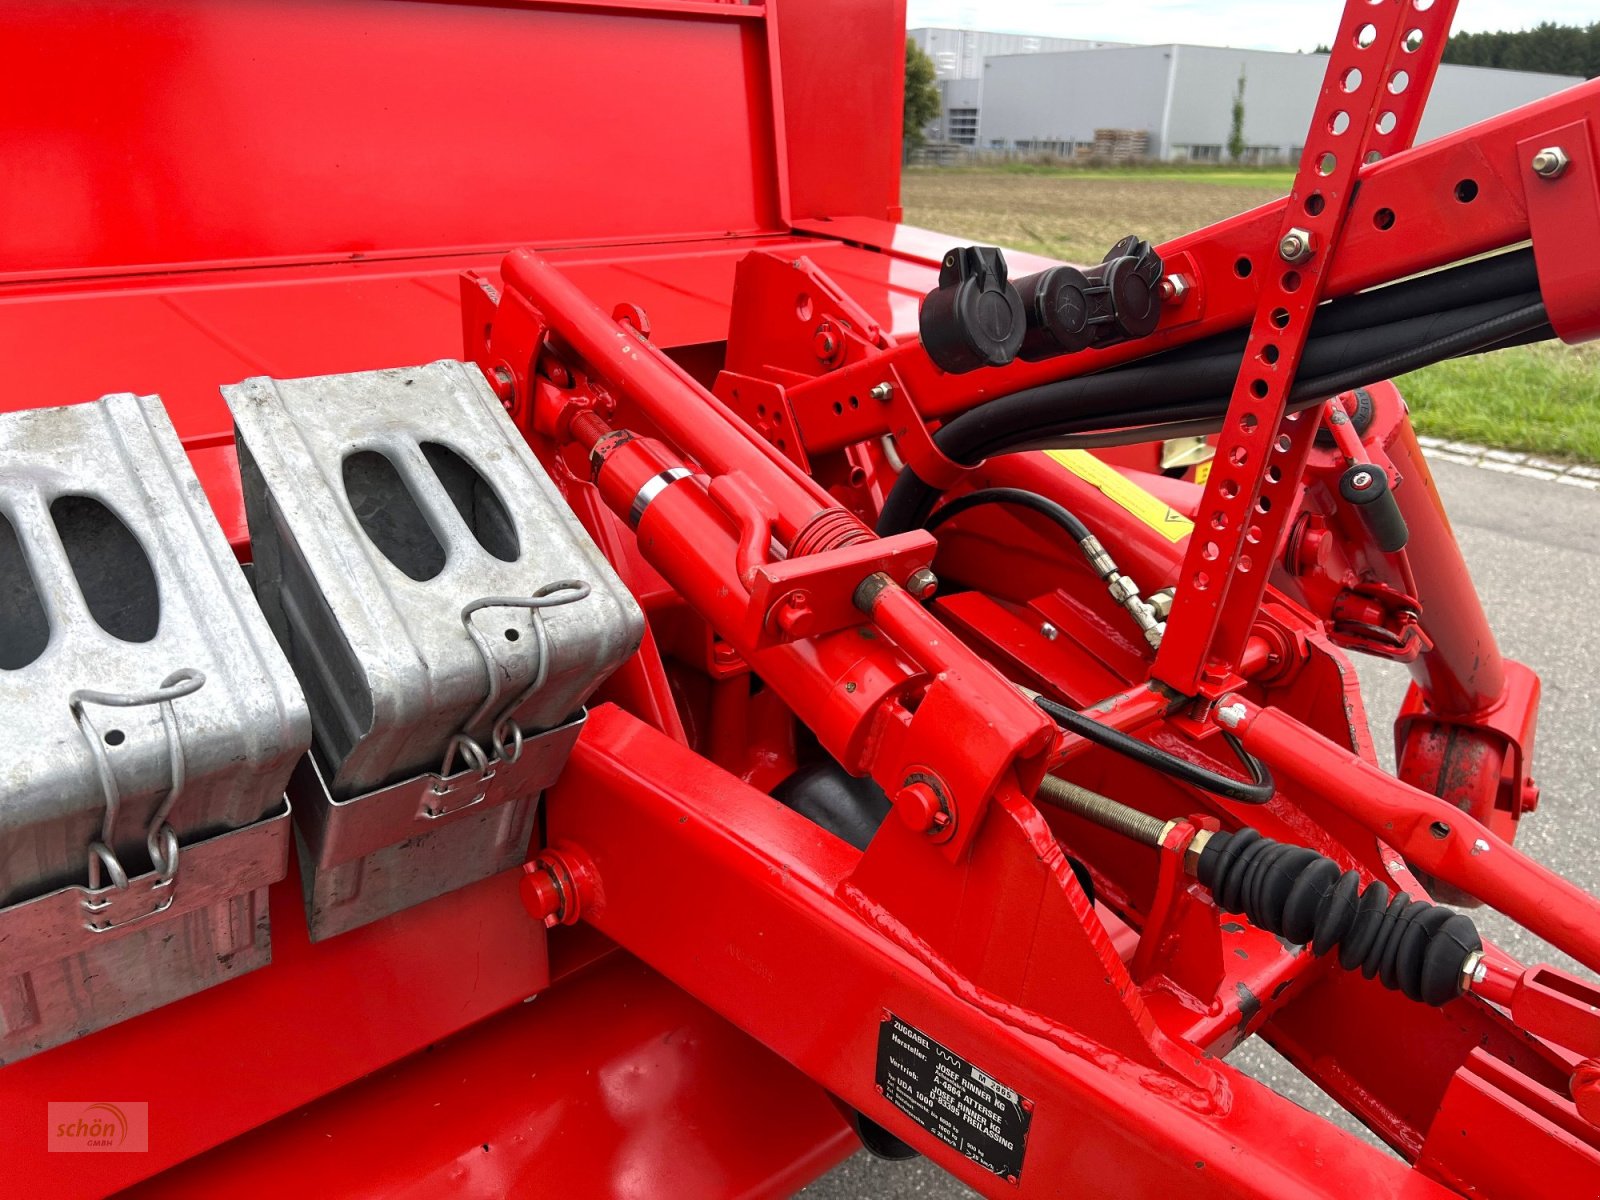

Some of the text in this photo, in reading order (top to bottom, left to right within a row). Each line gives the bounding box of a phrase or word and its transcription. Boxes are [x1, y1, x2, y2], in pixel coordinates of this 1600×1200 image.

[894, 1021, 930, 1050] ZUGGABEL
[890, 1056, 1001, 1134] Vertrieb: JOSEF RINNER KG
[892, 1033, 1006, 1112] Hersteller: JOSEF RINNER KG
[897, 1078, 912, 1094] UDA
[916, 1091, 934, 1108] 1000
[978, 1074, 1012, 1099] M 2865
[930, 1091, 1014, 1150] D-83395 FREILASSING
[934, 1076, 1002, 1124] A-4864 ATTERSEE
